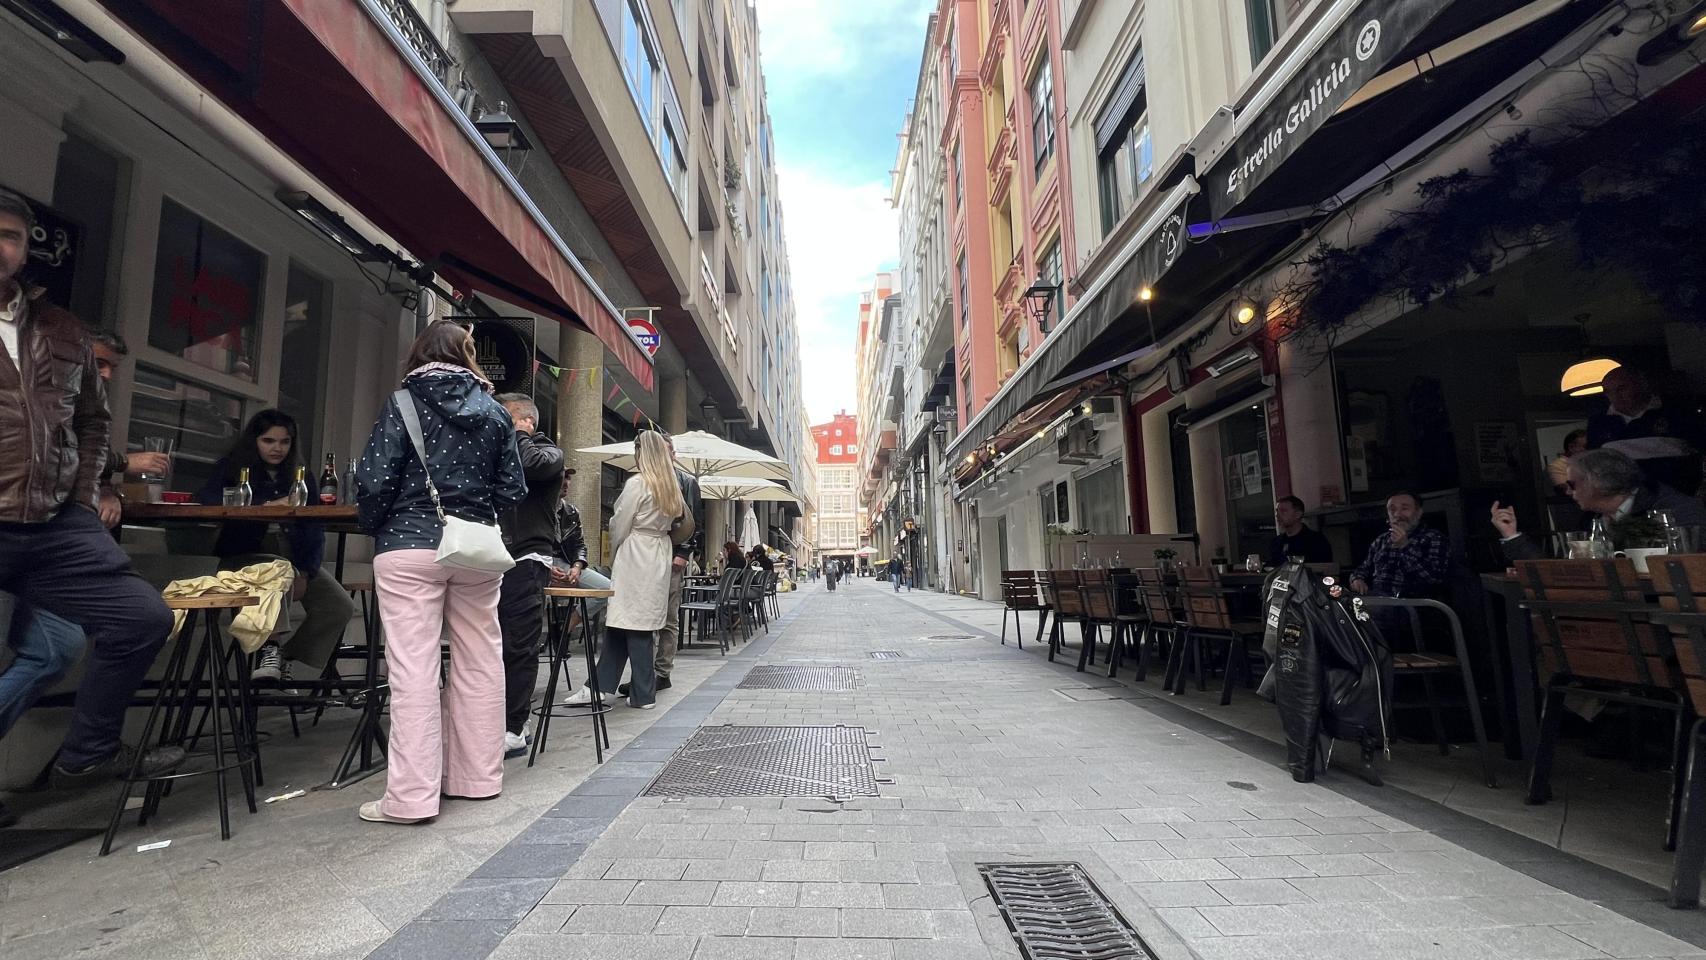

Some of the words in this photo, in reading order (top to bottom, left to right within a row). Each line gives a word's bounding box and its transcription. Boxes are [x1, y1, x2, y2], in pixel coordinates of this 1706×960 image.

[1226, 127, 1283, 196] Estrella
[1285, 57, 1351, 134] Galicia
[637, 335, 655, 345] TOL
